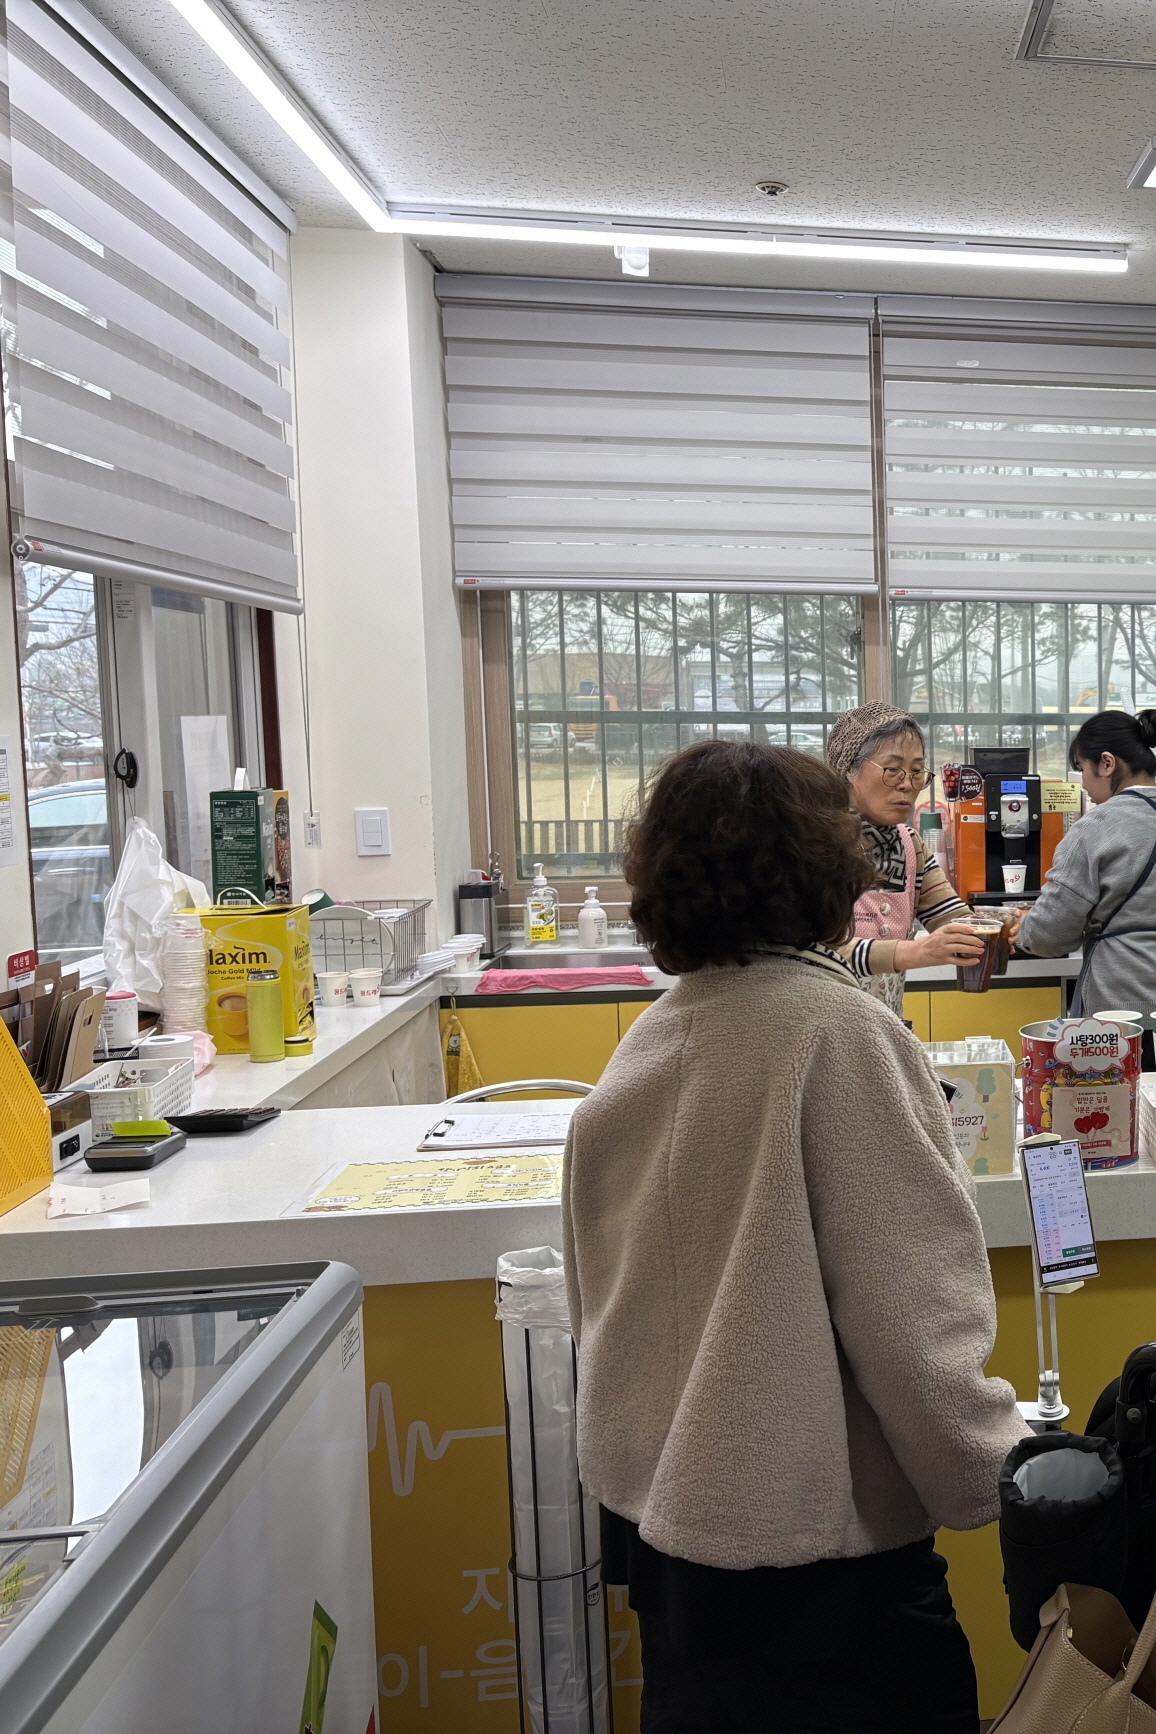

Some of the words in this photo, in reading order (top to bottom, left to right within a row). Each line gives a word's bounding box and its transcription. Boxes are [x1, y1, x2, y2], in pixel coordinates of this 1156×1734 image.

[13, 955, 30, 968] 비상벨
[1070, 1033, 1118, 1047] 사탕300원
[1070, 1046, 1118, 1058] 두개500원
